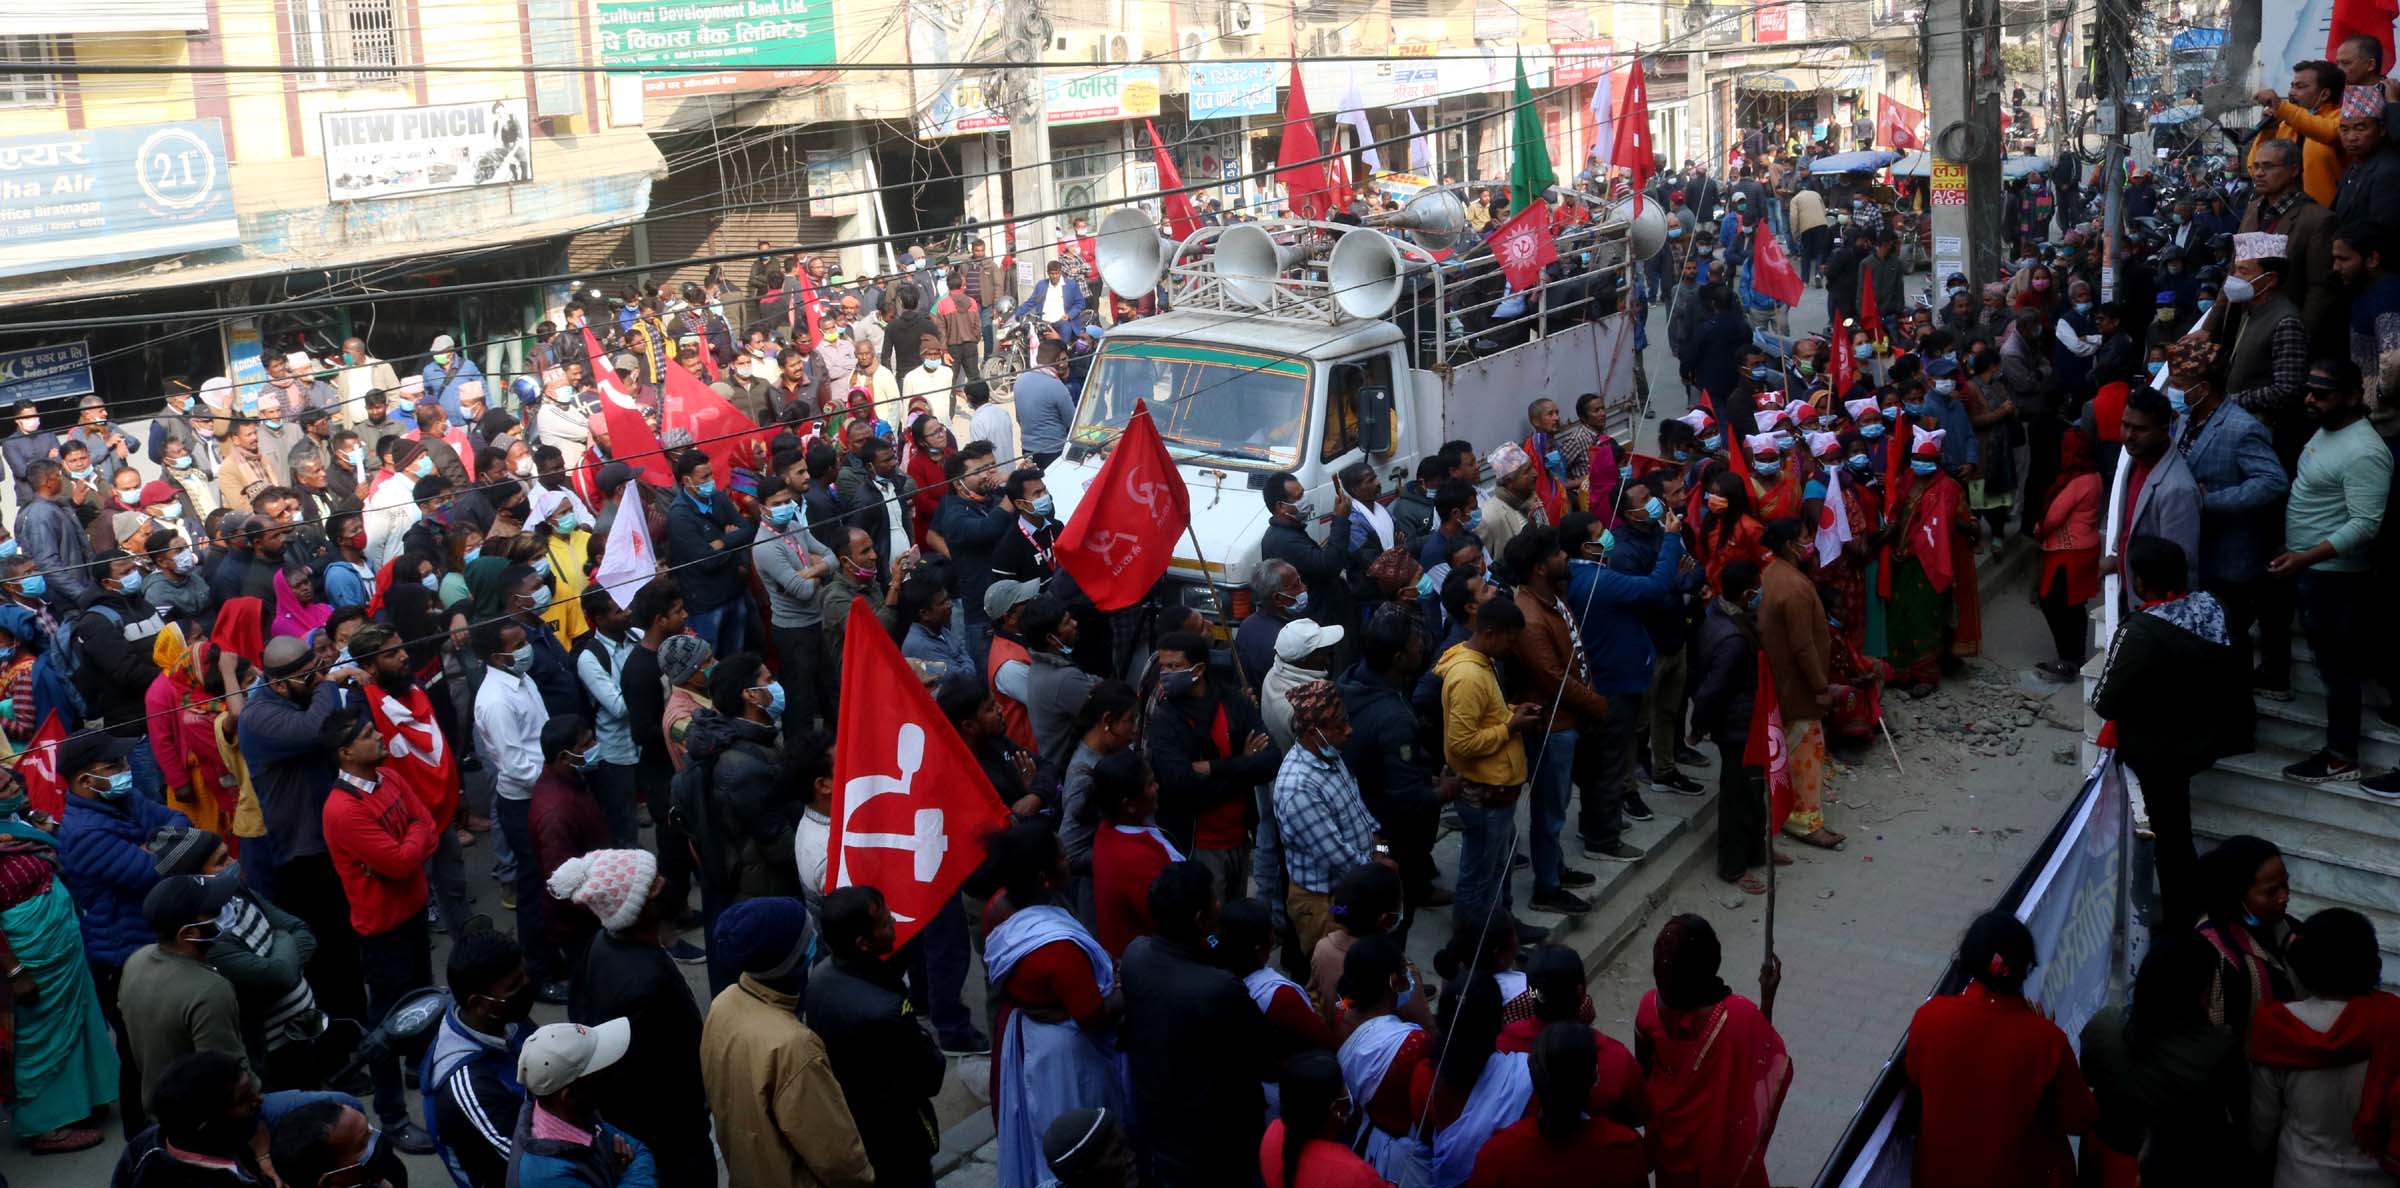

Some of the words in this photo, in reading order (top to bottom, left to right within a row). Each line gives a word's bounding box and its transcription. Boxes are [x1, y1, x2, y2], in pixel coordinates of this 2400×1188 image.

[659, 3, 743, 22] Development
[747, 0, 782, 16] Bank
[626, 28, 691, 49] विकास
[736, 19, 808, 42] लिमिटेड
[1066, 76, 1119, 99] ग्लास
[331, 115, 394, 146] NEW
[402, 107, 485, 140] PINCH
[52, 174, 97, 194] Air
[1933, 190, 1956, 199] A/C
